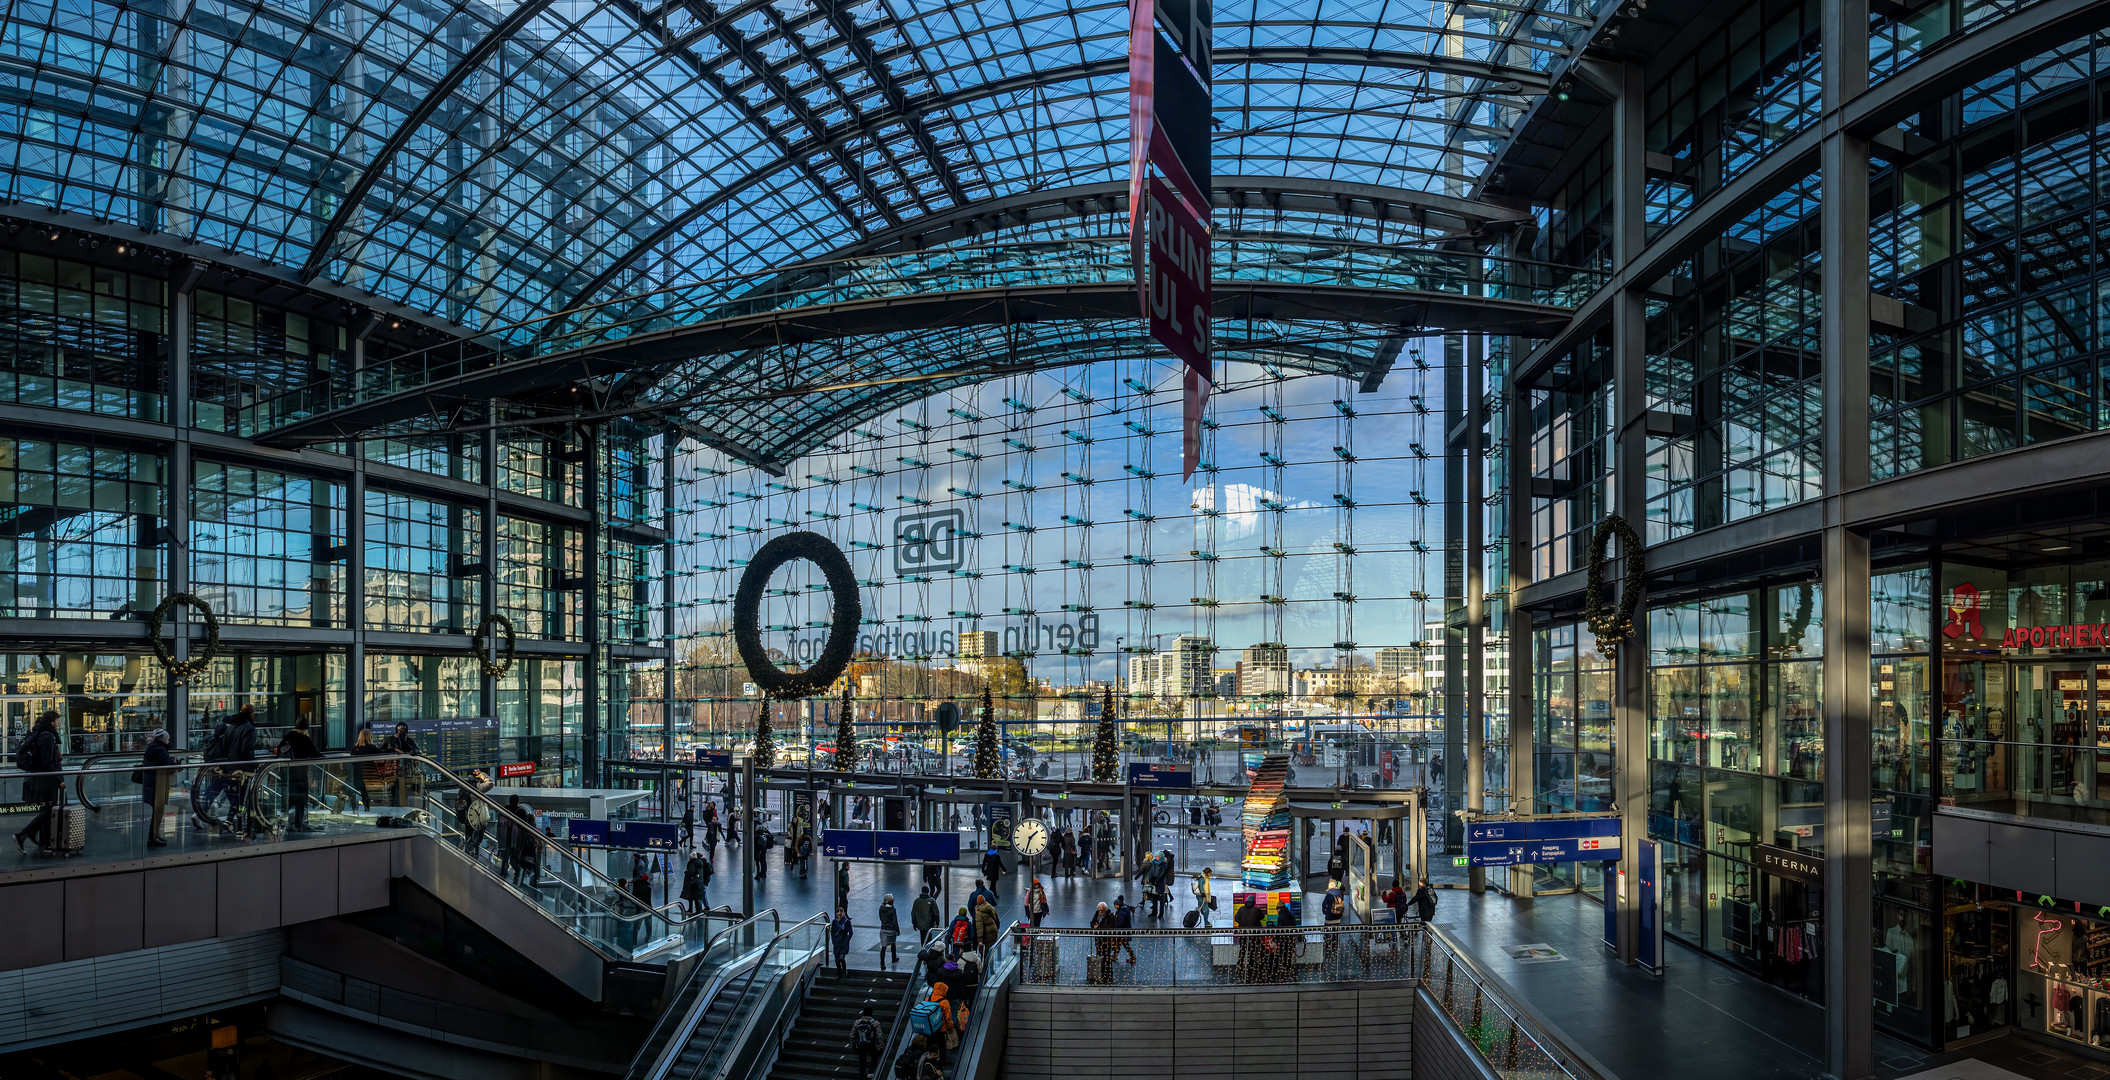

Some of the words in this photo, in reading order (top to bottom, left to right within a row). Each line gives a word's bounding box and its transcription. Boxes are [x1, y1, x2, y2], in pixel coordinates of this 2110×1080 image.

[1150, 194, 1211, 294] RLIN
[2002, 622, 2110, 649] APOTHEK
[15, 804, 41, 812] WHISKY
[546, 809, 585, 819] Information
[615, 823, 623, 831] U
[1765, 854, 1819, 876] ETERNA
